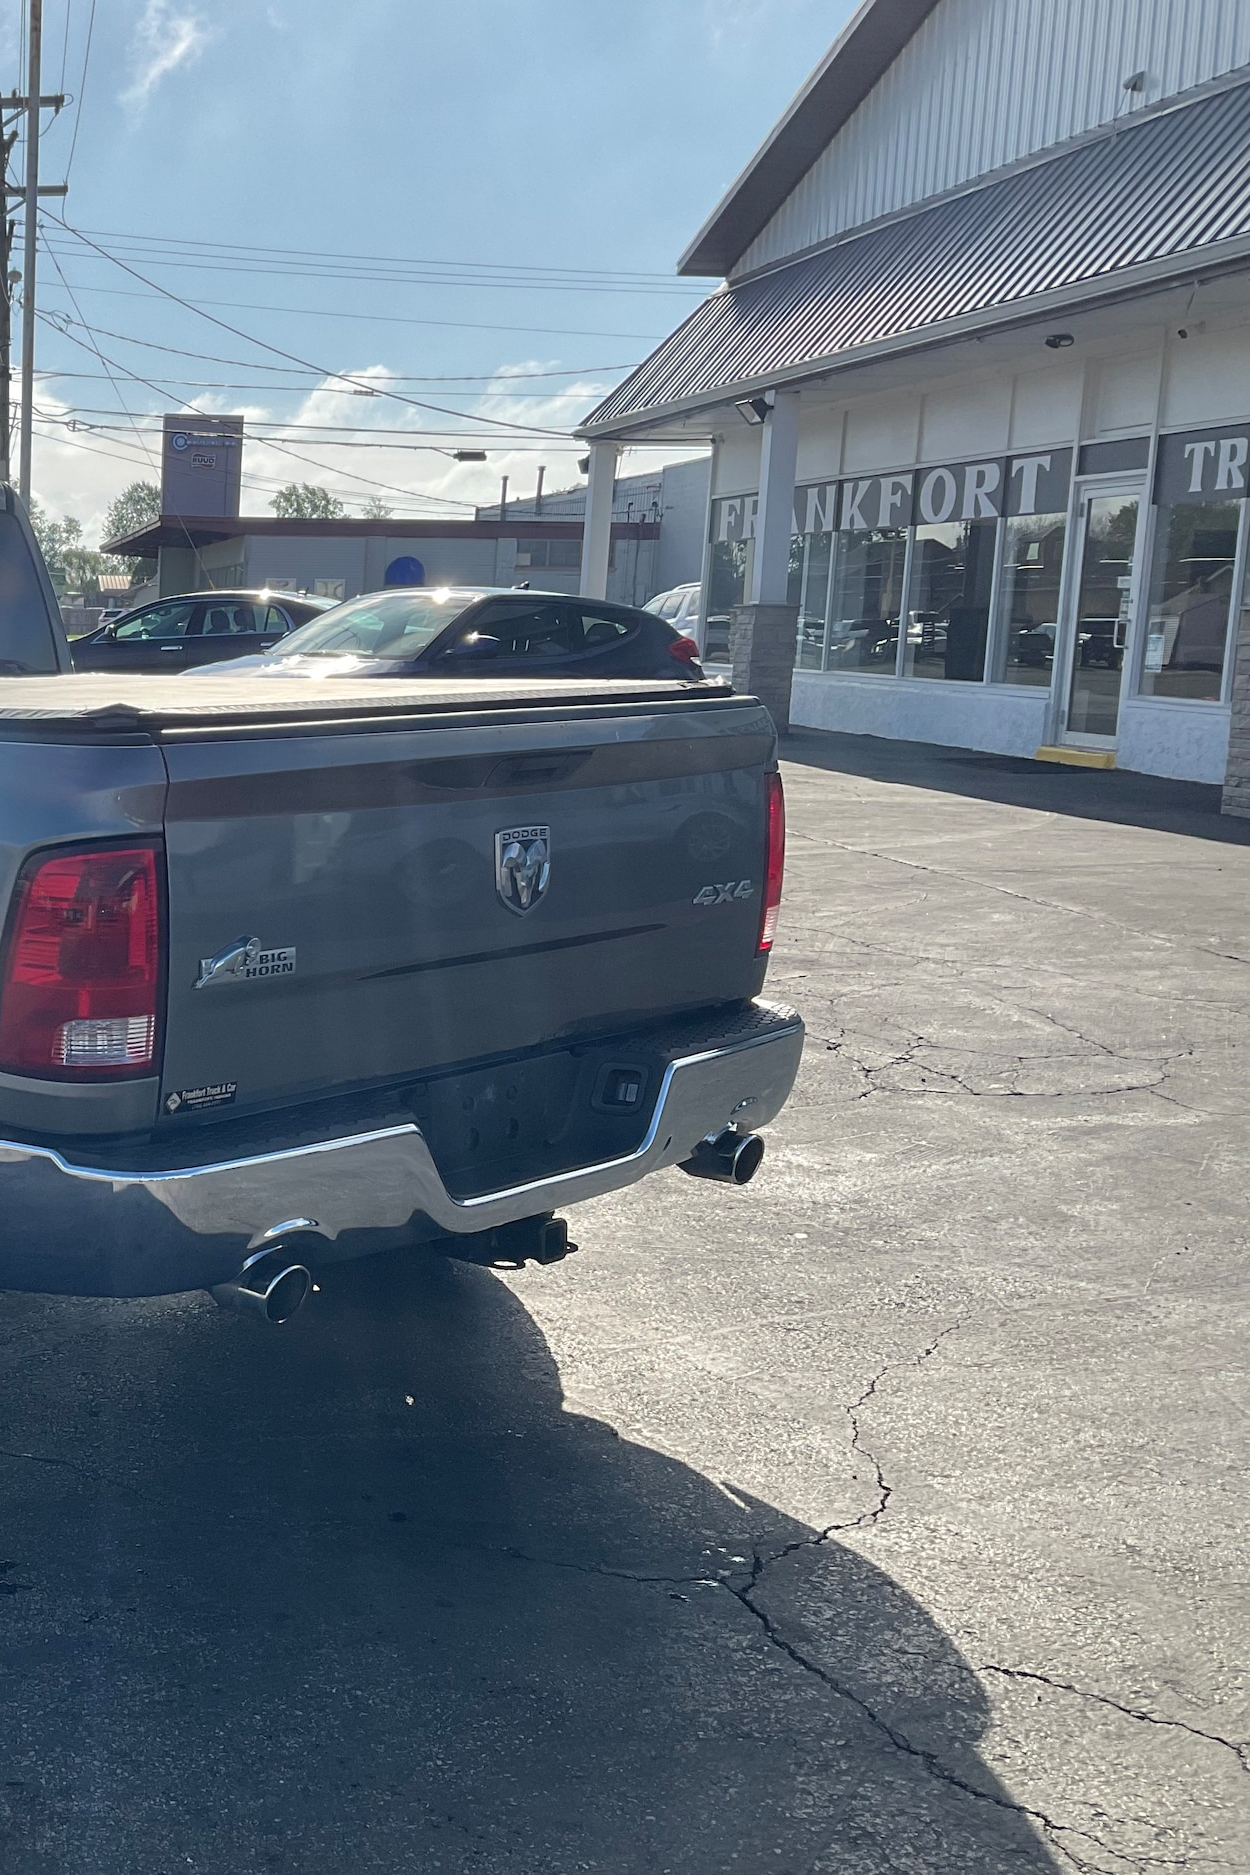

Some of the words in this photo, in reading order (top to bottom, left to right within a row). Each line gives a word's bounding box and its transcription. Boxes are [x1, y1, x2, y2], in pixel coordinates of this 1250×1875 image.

[718, 455, 1051, 541] FRNKFORT
[502, 828, 547, 842] DODGE
[692, 879, 754, 906] 4X4
[259, 951, 287, 965] BIG
[245, 962, 293, 978] HORN
[181, 1088, 206, 1101] Frankfort
[206, 1086, 221, 1096] Truck
[226, 1083, 237, 1092] Car
